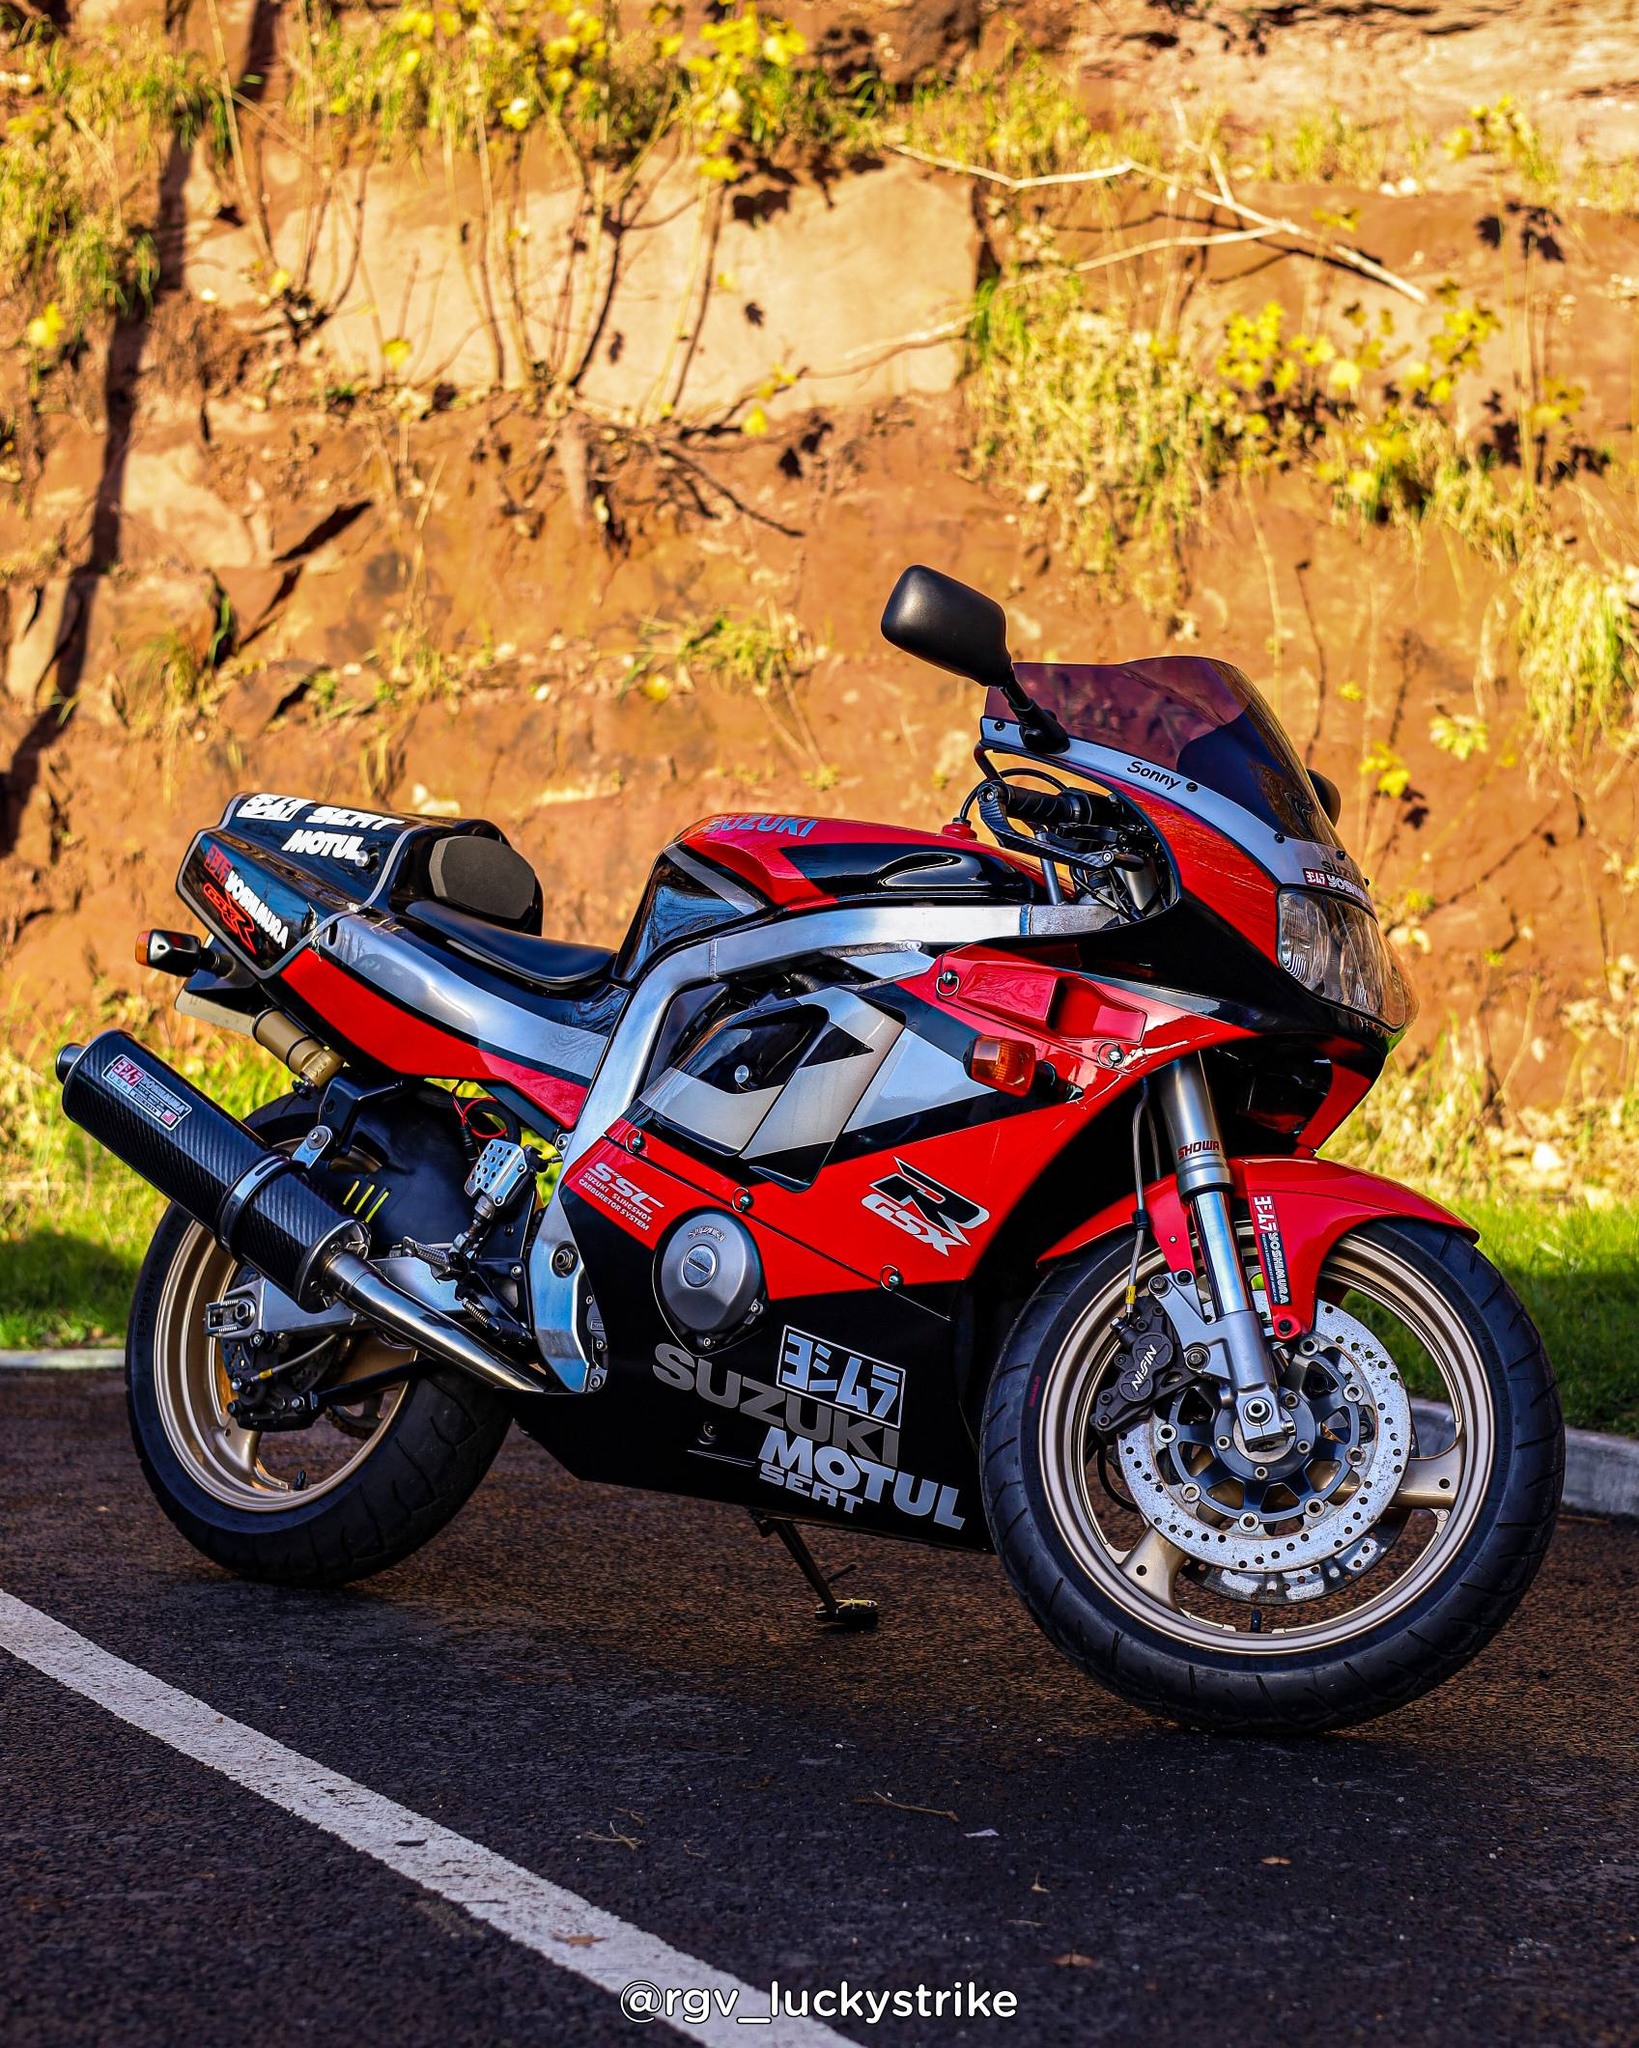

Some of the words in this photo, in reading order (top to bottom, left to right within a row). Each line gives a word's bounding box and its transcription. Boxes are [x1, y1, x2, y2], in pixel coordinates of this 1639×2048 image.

[1127, 761, 1181, 790] Sonny
[281, 829, 366, 861] MOTUL
[703, 813, 818, 838] SUZUKI
[223, 870, 289, 950] YOSHIMURA
[1178, 1141, 1220, 1160] SHOWA
[578, 1178, 621, 1212] CARBURETOR
[619, 1208, 650, 1231] SYSTEM
[583, 1172, 610, 1193] SUZUKI
[611, 1193, 652, 1222] SLINGSHOT
[688, 1226, 726, 1243] SUZUKI
[861, 1193, 962, 1256] GSX
[1253, 1195, 1279, 1232] ヨシムラ
[1267, 1231, 1290, 1304] YOSHIMURA
[781, 1332, 900, 1419] ヨシムラ
[652, 1343, 900, 1468] SUZUKI
[757, 1425, 966, 1530] MOTUL
[758, 1461, 863, 1513] SERT
